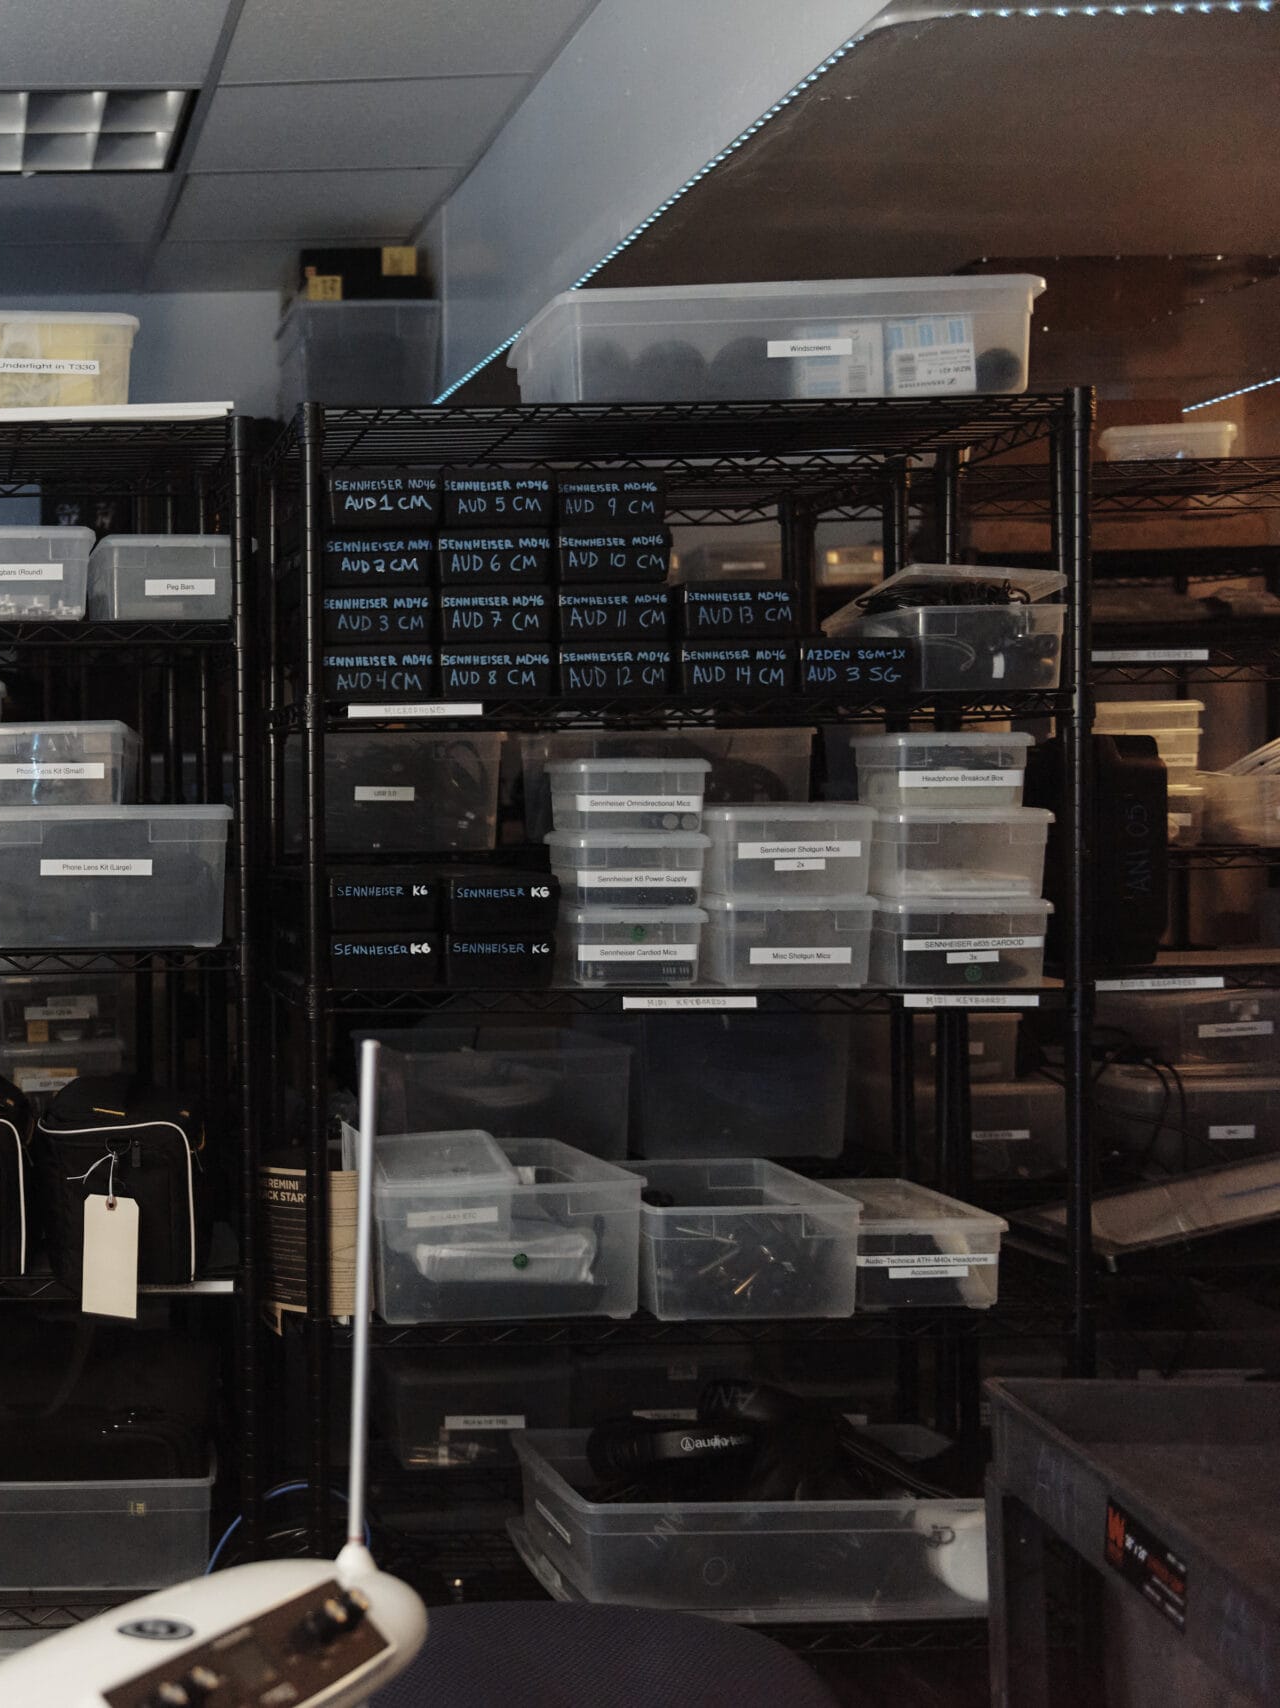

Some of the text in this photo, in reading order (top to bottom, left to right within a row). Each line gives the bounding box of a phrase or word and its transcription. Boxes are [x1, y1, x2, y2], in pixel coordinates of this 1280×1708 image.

[790, 343, 832, 352] Windscreens
[55, 362, 65, 370] in
[69, 363, 96, 372] T330
[335, 479, 403, 490] SENNHEISER
[444, 480, 512, 492] SENNHEISER
[558, 484, 620, 493] SENNHEISER
[344, 494, 433, 511] AUD 1 CM
[458, 496, 542, 514] AUD 5 CM
[565, 498, 656, 516] AUD 9 CM
[327, 541, 404, 552] SENNHEISER
[440, 538, 514, 550] SENNHEISER
[561, 536, 626, 548] SENNHEISER
[341, 556, 420, 574] AUD 2 CM
[451, 554, 537, 572] AUD 6 CM
[568, 552, 666, 570] AUD 10 CM
[18, 568, 44, 577] (Round)
[166, 583, 196, 592] Peg Bars
[443, 596, 510, 608] SENNHEISER
[561, 594, 628, 606] SENNHEISER
[688, 592, 753, 602] SENNHEISER
[324, 597, 388, 610] SENNHEISER
[452, 609, 540, 630] AUD 7 CM
[570, 608, 666, 628] AUD 11 CM
[698, 605, 792, 626] AUD 13 CM
[337, 614, 424, 632] AUD 3 CM
[324, 655, 398, 667] SENNHEISER
[442, 653, 513, 666] SENNHEISER
[562, 651, 634, 663] SENNHEISER
[683, 650, 751, 662] SENNHEISER
[806, 650, 851, 661] AZDEN
[336, 670, 423, 690] AUD 4 CM
[450, 668, 536, 687] AUD 8 CM
[569, 665, 665, 689] AUD 12 CM
[693, 666, 784, 687] AUD 14 CM
[807, 666, 902, 683] AUD 3 SG
[54, 768, 85, 776] Kit (Small)
[922, 774, 1004, 784] Headphone Breakout Box
[590, 800, 690, 808] Sennheiser Omnidirectional Mics
[760, 845, 841, 856] Sennheiser Shotgun Mics
[62, 863, 132, 872] Phone Lens Kit (Large)
[598, 875, 634, 884] Sennheiser
[644, 875, 664, 883] Power
[666, 875, 688, 885] Supply
[336, 885, 429, 898] SENNHEISER K6
[457, 886, 550, 899] SENNHEISER K6
[334, 942, 432, 956] SENNHEISER K6
[453, 942, 550, 954] SENNHEISER K6
[924, 939, 972, 948] SENNHEISER
[600, 948, 636, 957] Sennheiser
[662, 948, 678, 957] Mics
[772, 952, 831, 962] Misc Shotgun Mics
[264, 1178, 299, 1190] REMINI
[280, 1191, 307, 1203] STAR
[864, 1256, 915, 1264] Audio-Technica
[953, 1256, 988, 1264] Headphone
